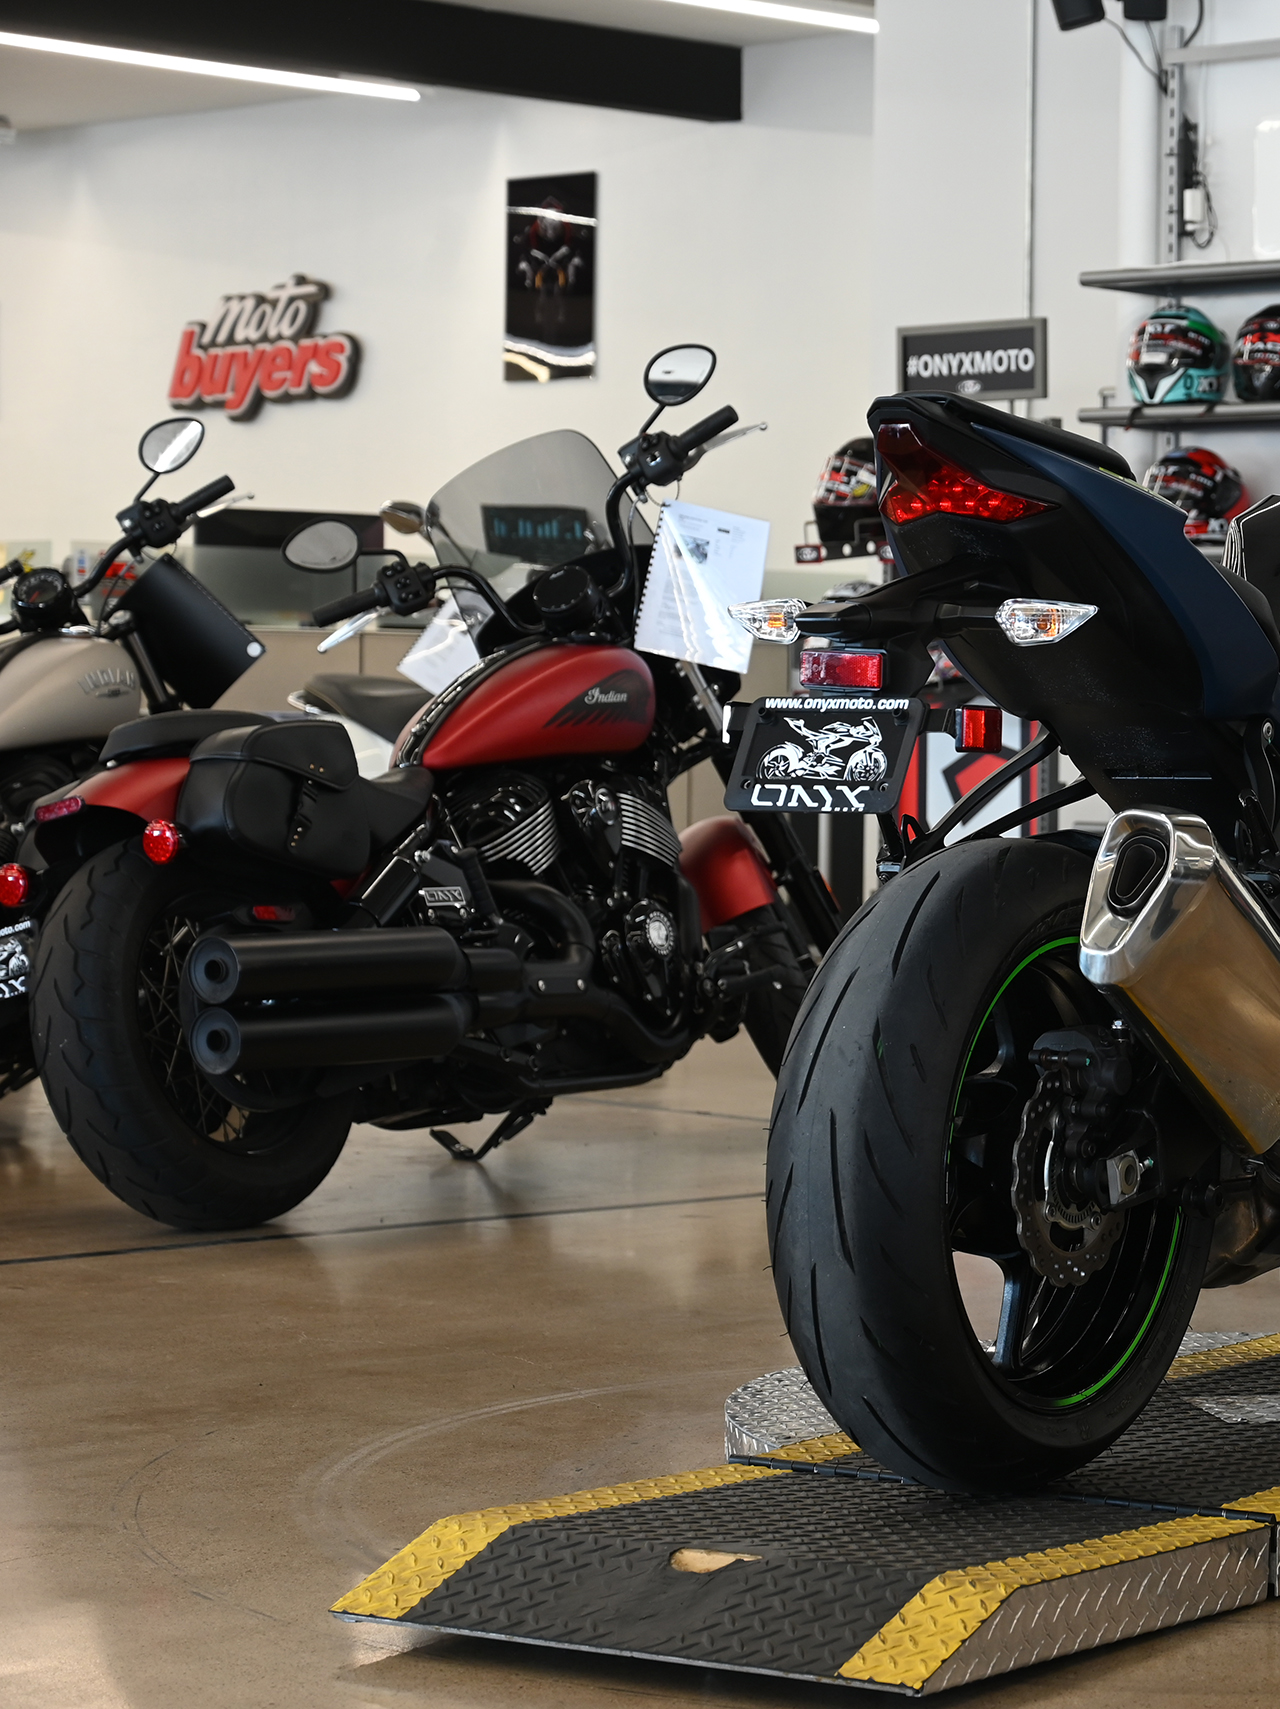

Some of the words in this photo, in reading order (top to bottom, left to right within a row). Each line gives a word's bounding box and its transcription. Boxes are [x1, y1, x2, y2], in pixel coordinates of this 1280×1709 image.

[201, 277, 319, 345] Moto
[168, 322, 350, 413] buyers
[907, 347, 1035, 378] #ONYXMOTO
[584, 687, 628, 705] Indian
[765, 697, 909, 712] www.onyxmoto.com
[751, 783, 870, 812] ONYX
